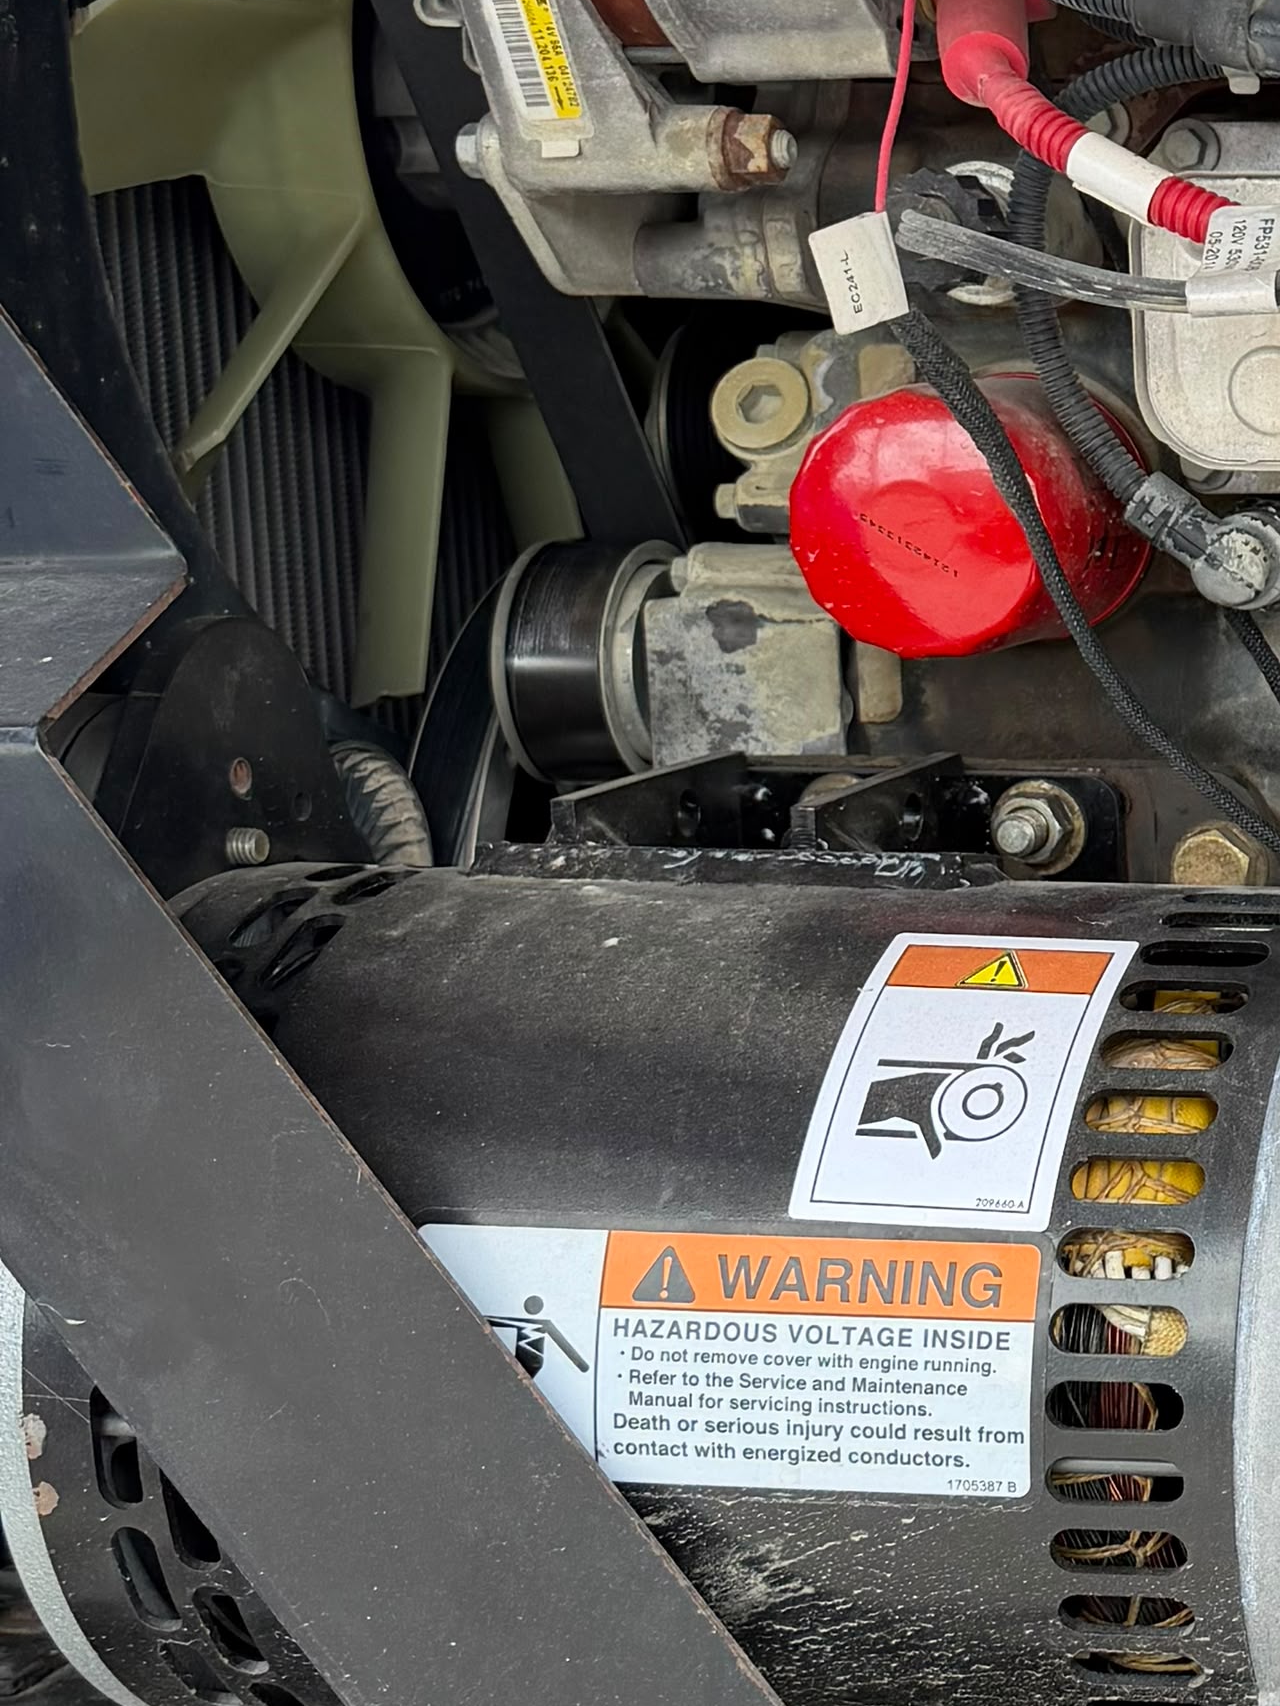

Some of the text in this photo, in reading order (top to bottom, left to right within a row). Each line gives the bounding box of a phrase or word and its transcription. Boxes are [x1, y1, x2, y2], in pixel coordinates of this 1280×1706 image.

[840, 249, 863, 314] EC241-L
[717, 1254, 1003, 1309] WARNING
[613, 1318, 1011, 1351] HAZARDOUS VOLTAGE INSIDE
[631, 1346, 997, 1377] Do not remove cover with engine running.
[629, 1369, 968, 1396] Refer to the Service and Maintenance
[629, 1391, 932, 1417] Manual for servicing instructions.
[614, 1413, 1024, 1444] Death or serious injury could result from
[613, 1441, 970, 1468] contact with energized conductors.
[947, 1479, 1016, 1493] 1705387 B
